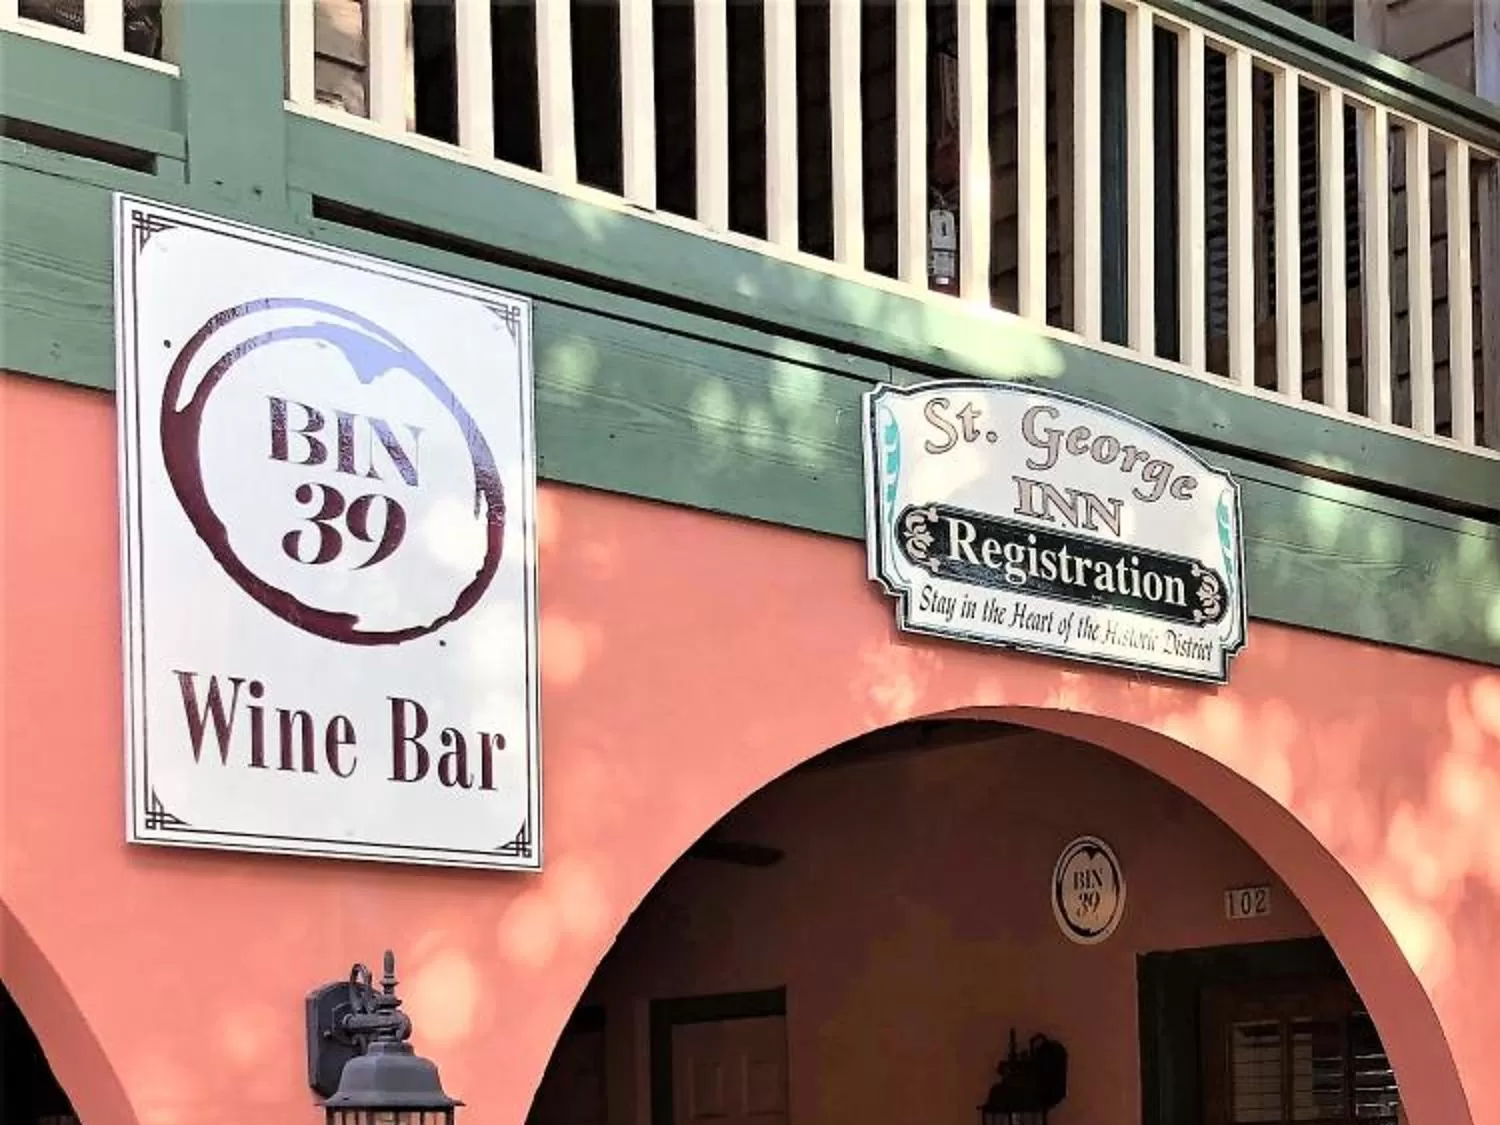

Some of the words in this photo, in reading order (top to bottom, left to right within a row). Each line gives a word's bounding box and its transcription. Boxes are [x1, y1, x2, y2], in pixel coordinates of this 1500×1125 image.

[266, 395, 426, 488] BIN
[923, 397, 998, 455] St.
[1021, 404, 1199, 503] George
[281, 482, 408, 571] 39
[1011, 475, 1125, 537] INN
[947, 516, 1188, 607] Registration
[919, 585, 957, 622] Stay
[961, 593, 977, 614] in
[982, 597, 1007, 625] the
[1008, 603, 1054, 634] Heart
[1057, 612, 1075, 643] of
[1077, 615, 1101, 641] the
[1101, 620, 1159, 652] Historic
[1163, 629, 1214, 662] District
[172, 669, 358, 780] Wine
[386, 696, 507, 792] Bar
[1073, 868, 1104, 891] BIN
[1077, 890, 1100, 917] 39
[1229, 889, 1267, 916] 102
